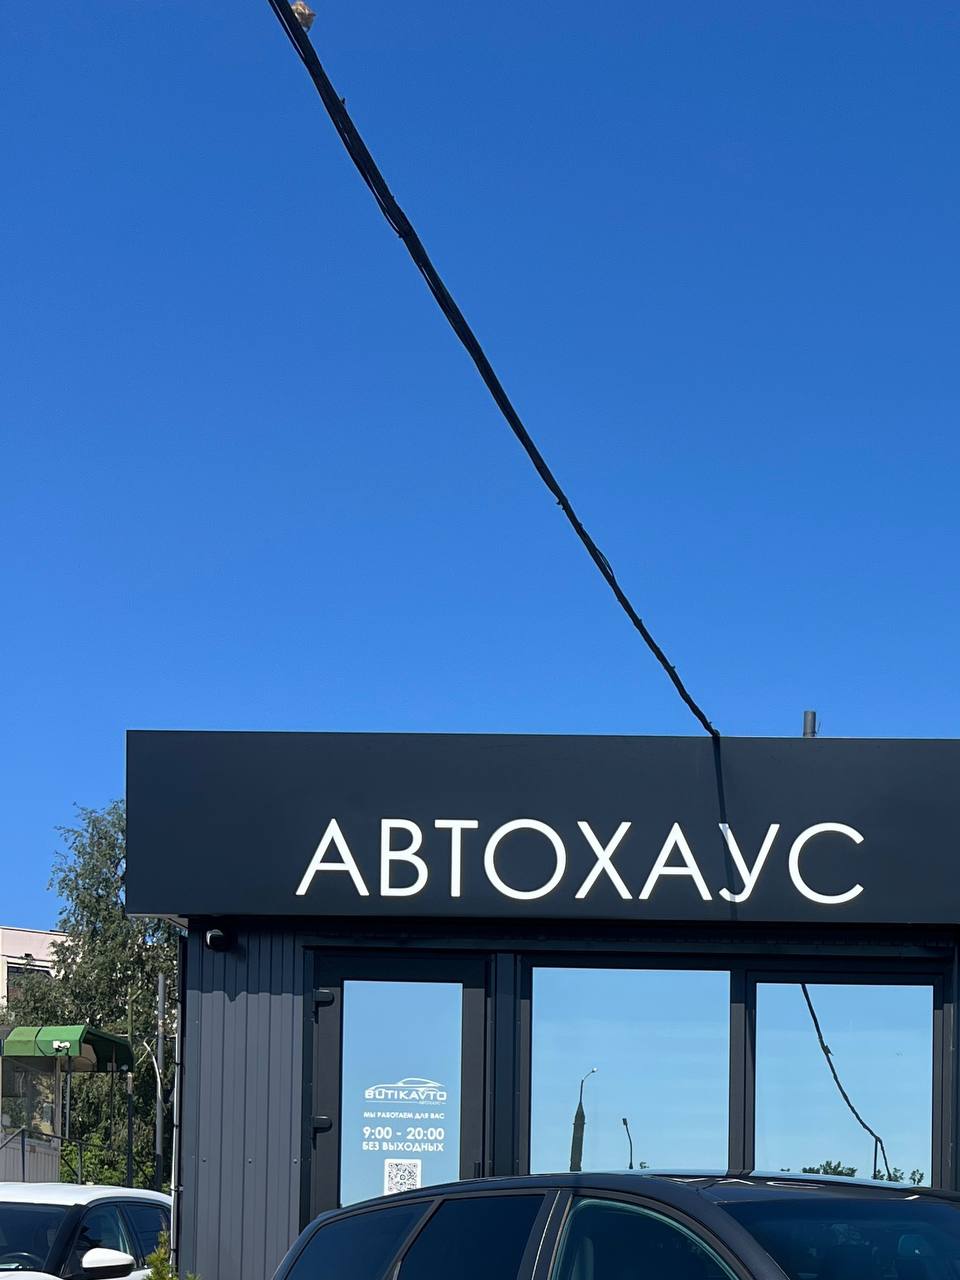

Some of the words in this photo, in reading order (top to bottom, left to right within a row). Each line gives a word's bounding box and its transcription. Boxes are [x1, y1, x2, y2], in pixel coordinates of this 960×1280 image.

[295, 818, 865, 904] АВТОХАУС
[364, 1089, 447, 1101] BUTIKAVTO
[363, 1126, 392, 1139] 9:00
[406, 1127, 445, 1140] 20:00
[362, 1141, 379, 1151] БЕЗ
[382, 1142, 444, 1152] ВЫХОДНЫХ
